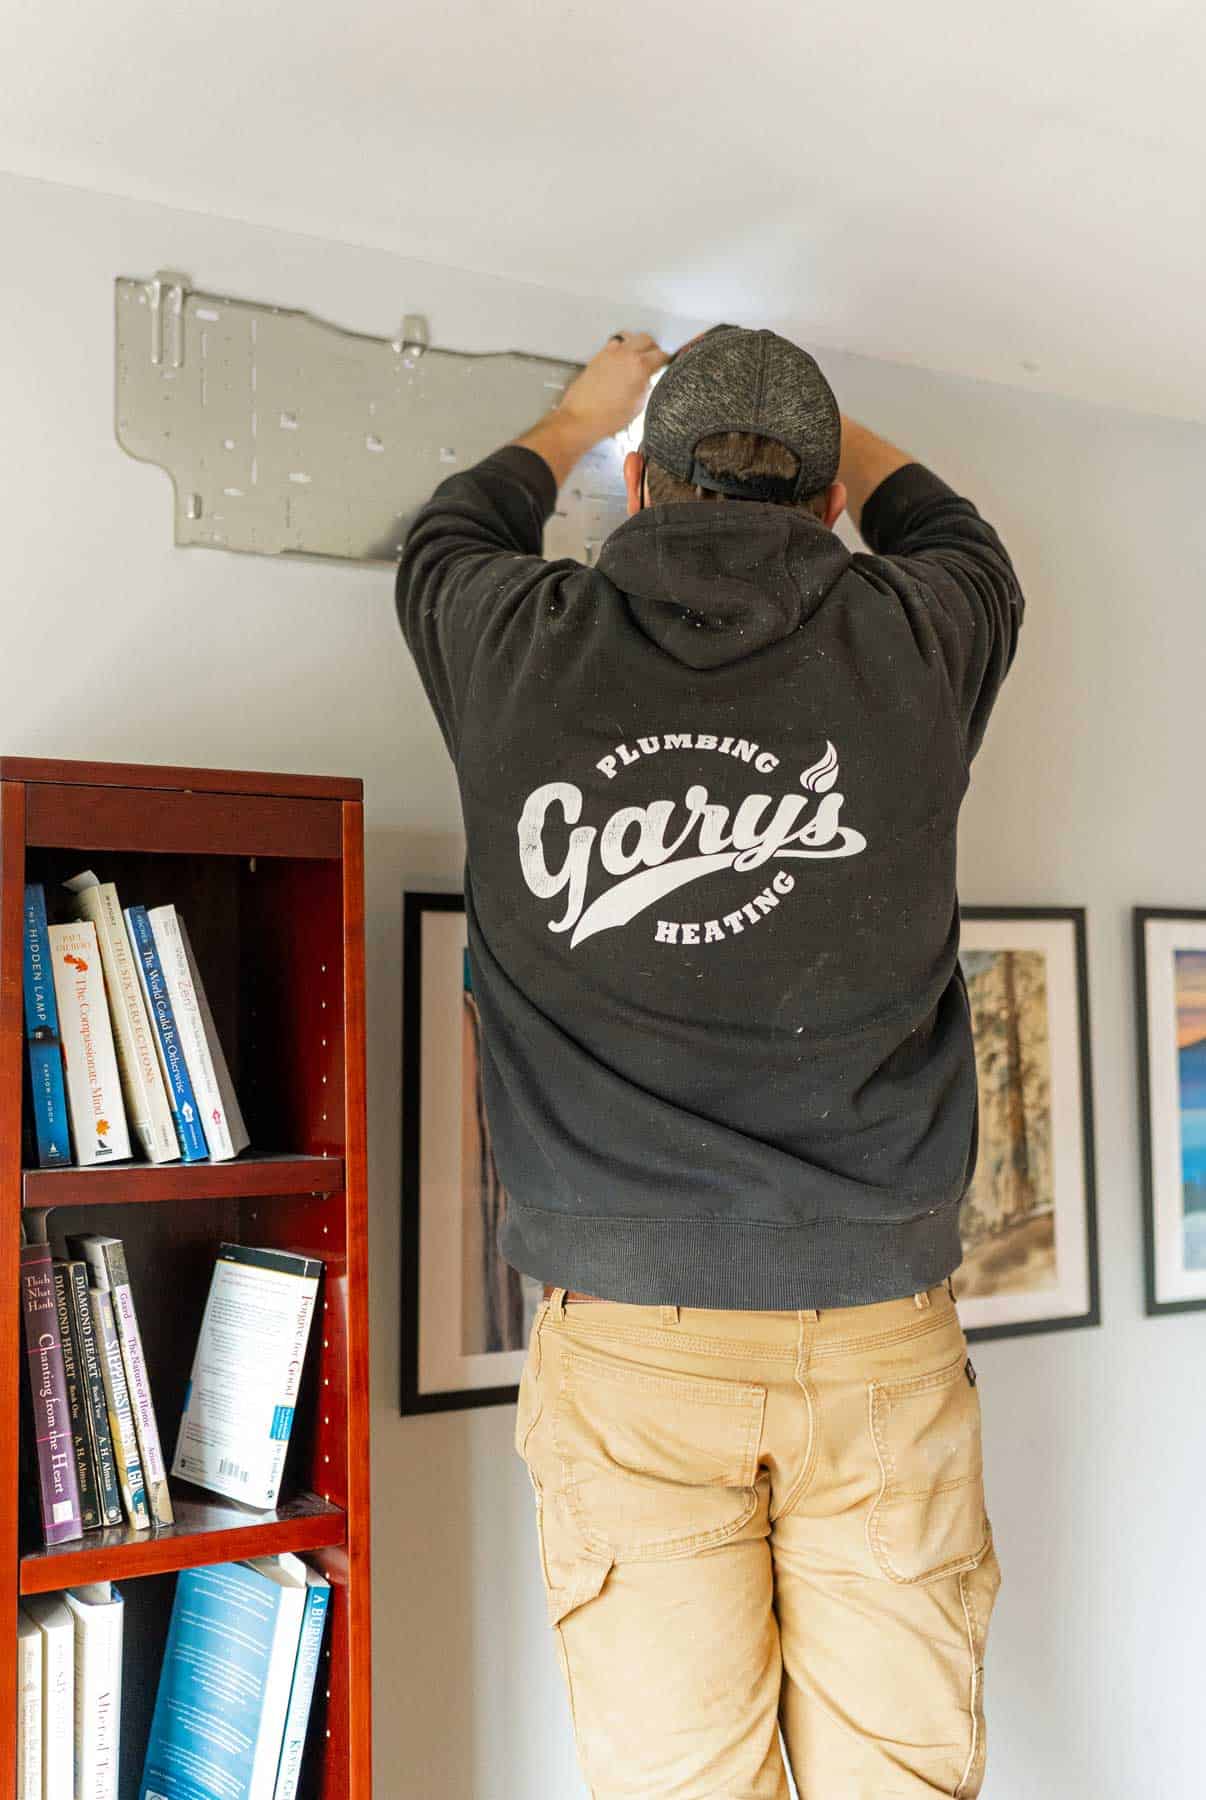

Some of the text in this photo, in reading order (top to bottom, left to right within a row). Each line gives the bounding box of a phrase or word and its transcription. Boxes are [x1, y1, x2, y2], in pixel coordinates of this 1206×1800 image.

[596, 734, 780, 779] PLUMBING
[655, 870, 796, 945] HEATING
[30, 929, 42, 980] HIDDEN
[33, 985, 47, 1021] LAMP
[120, 968, 131, 989] SIX
[126, 992, 154, 1084] PERFECTIONS
[143, 950, 185, 1094] The World Could Be Otherwise
[75, 979, 105, 1116] The Compassionate Mind
[25, 1275, 51, 1287] Thich
[28, 1287, 52, 1299] Nhat
[28, 1299, 54, 1312] Hanh
[55, 1275, 71, 1336] DIAMOND
[63, 1337, 75, 1378] HEART
[75, 1276, 92, 1337] DIAMOND
[85, 1336, 97, 1378] HEART
[128, 1336, 138, 1357] The
[131, 1355, 144, 1386] Nature
[39, 1333, 69, 1494] Chanting from the Heart
[312, 1594, 326, 1604] A
[304, 1606, 325, 1672] BURNING
